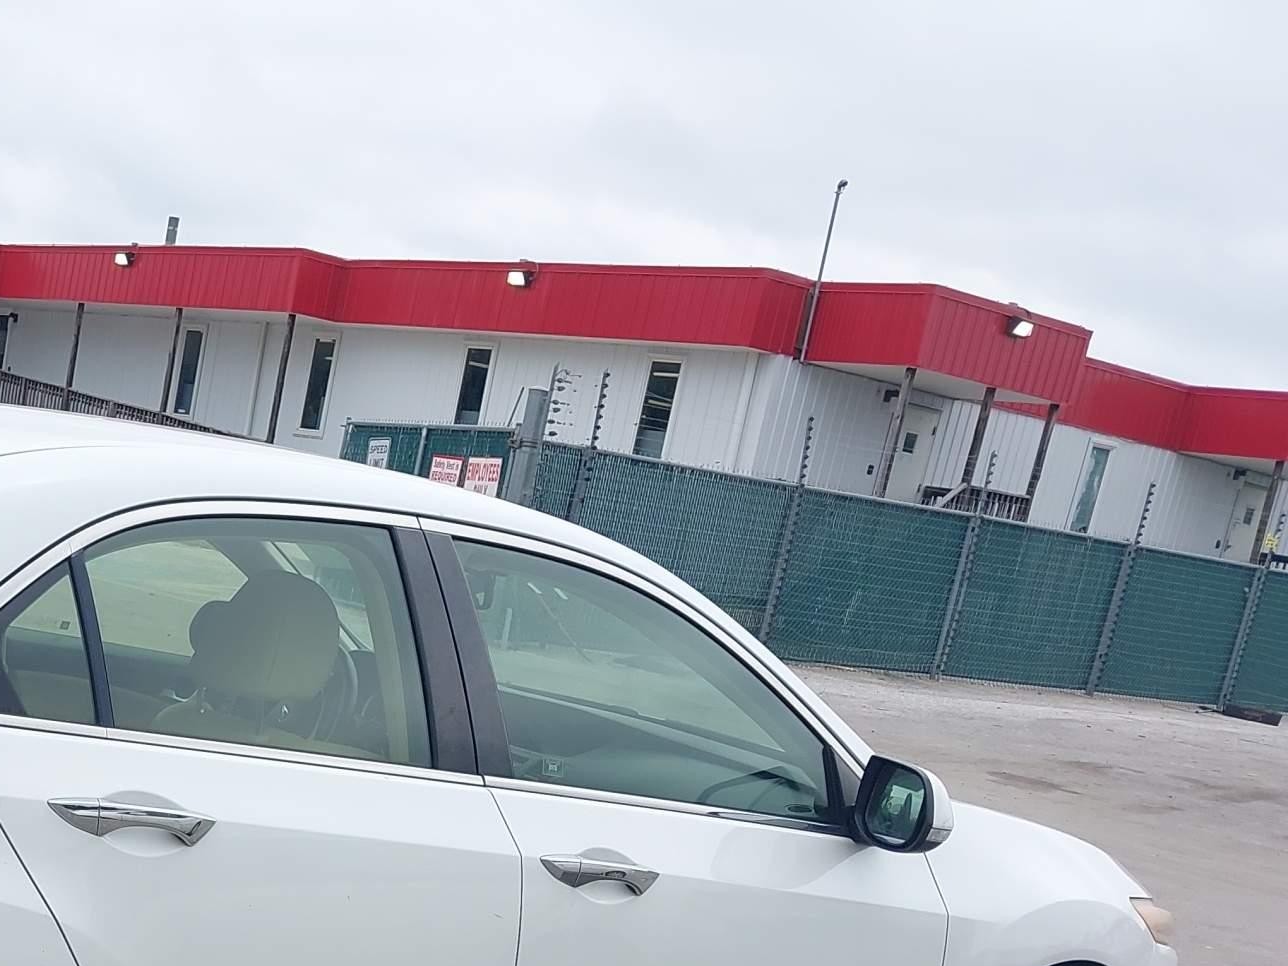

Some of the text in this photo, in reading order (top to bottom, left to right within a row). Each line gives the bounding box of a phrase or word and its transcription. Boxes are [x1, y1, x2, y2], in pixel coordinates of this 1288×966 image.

[369, 445, 388, 454] SPEED
[434, 459, 445, 470] Safety
[446, 461, 454, 470] Vest
[431, 470, 457, 482] REQUIRED
[467, 463, 500, 482] EMPLOYEES
